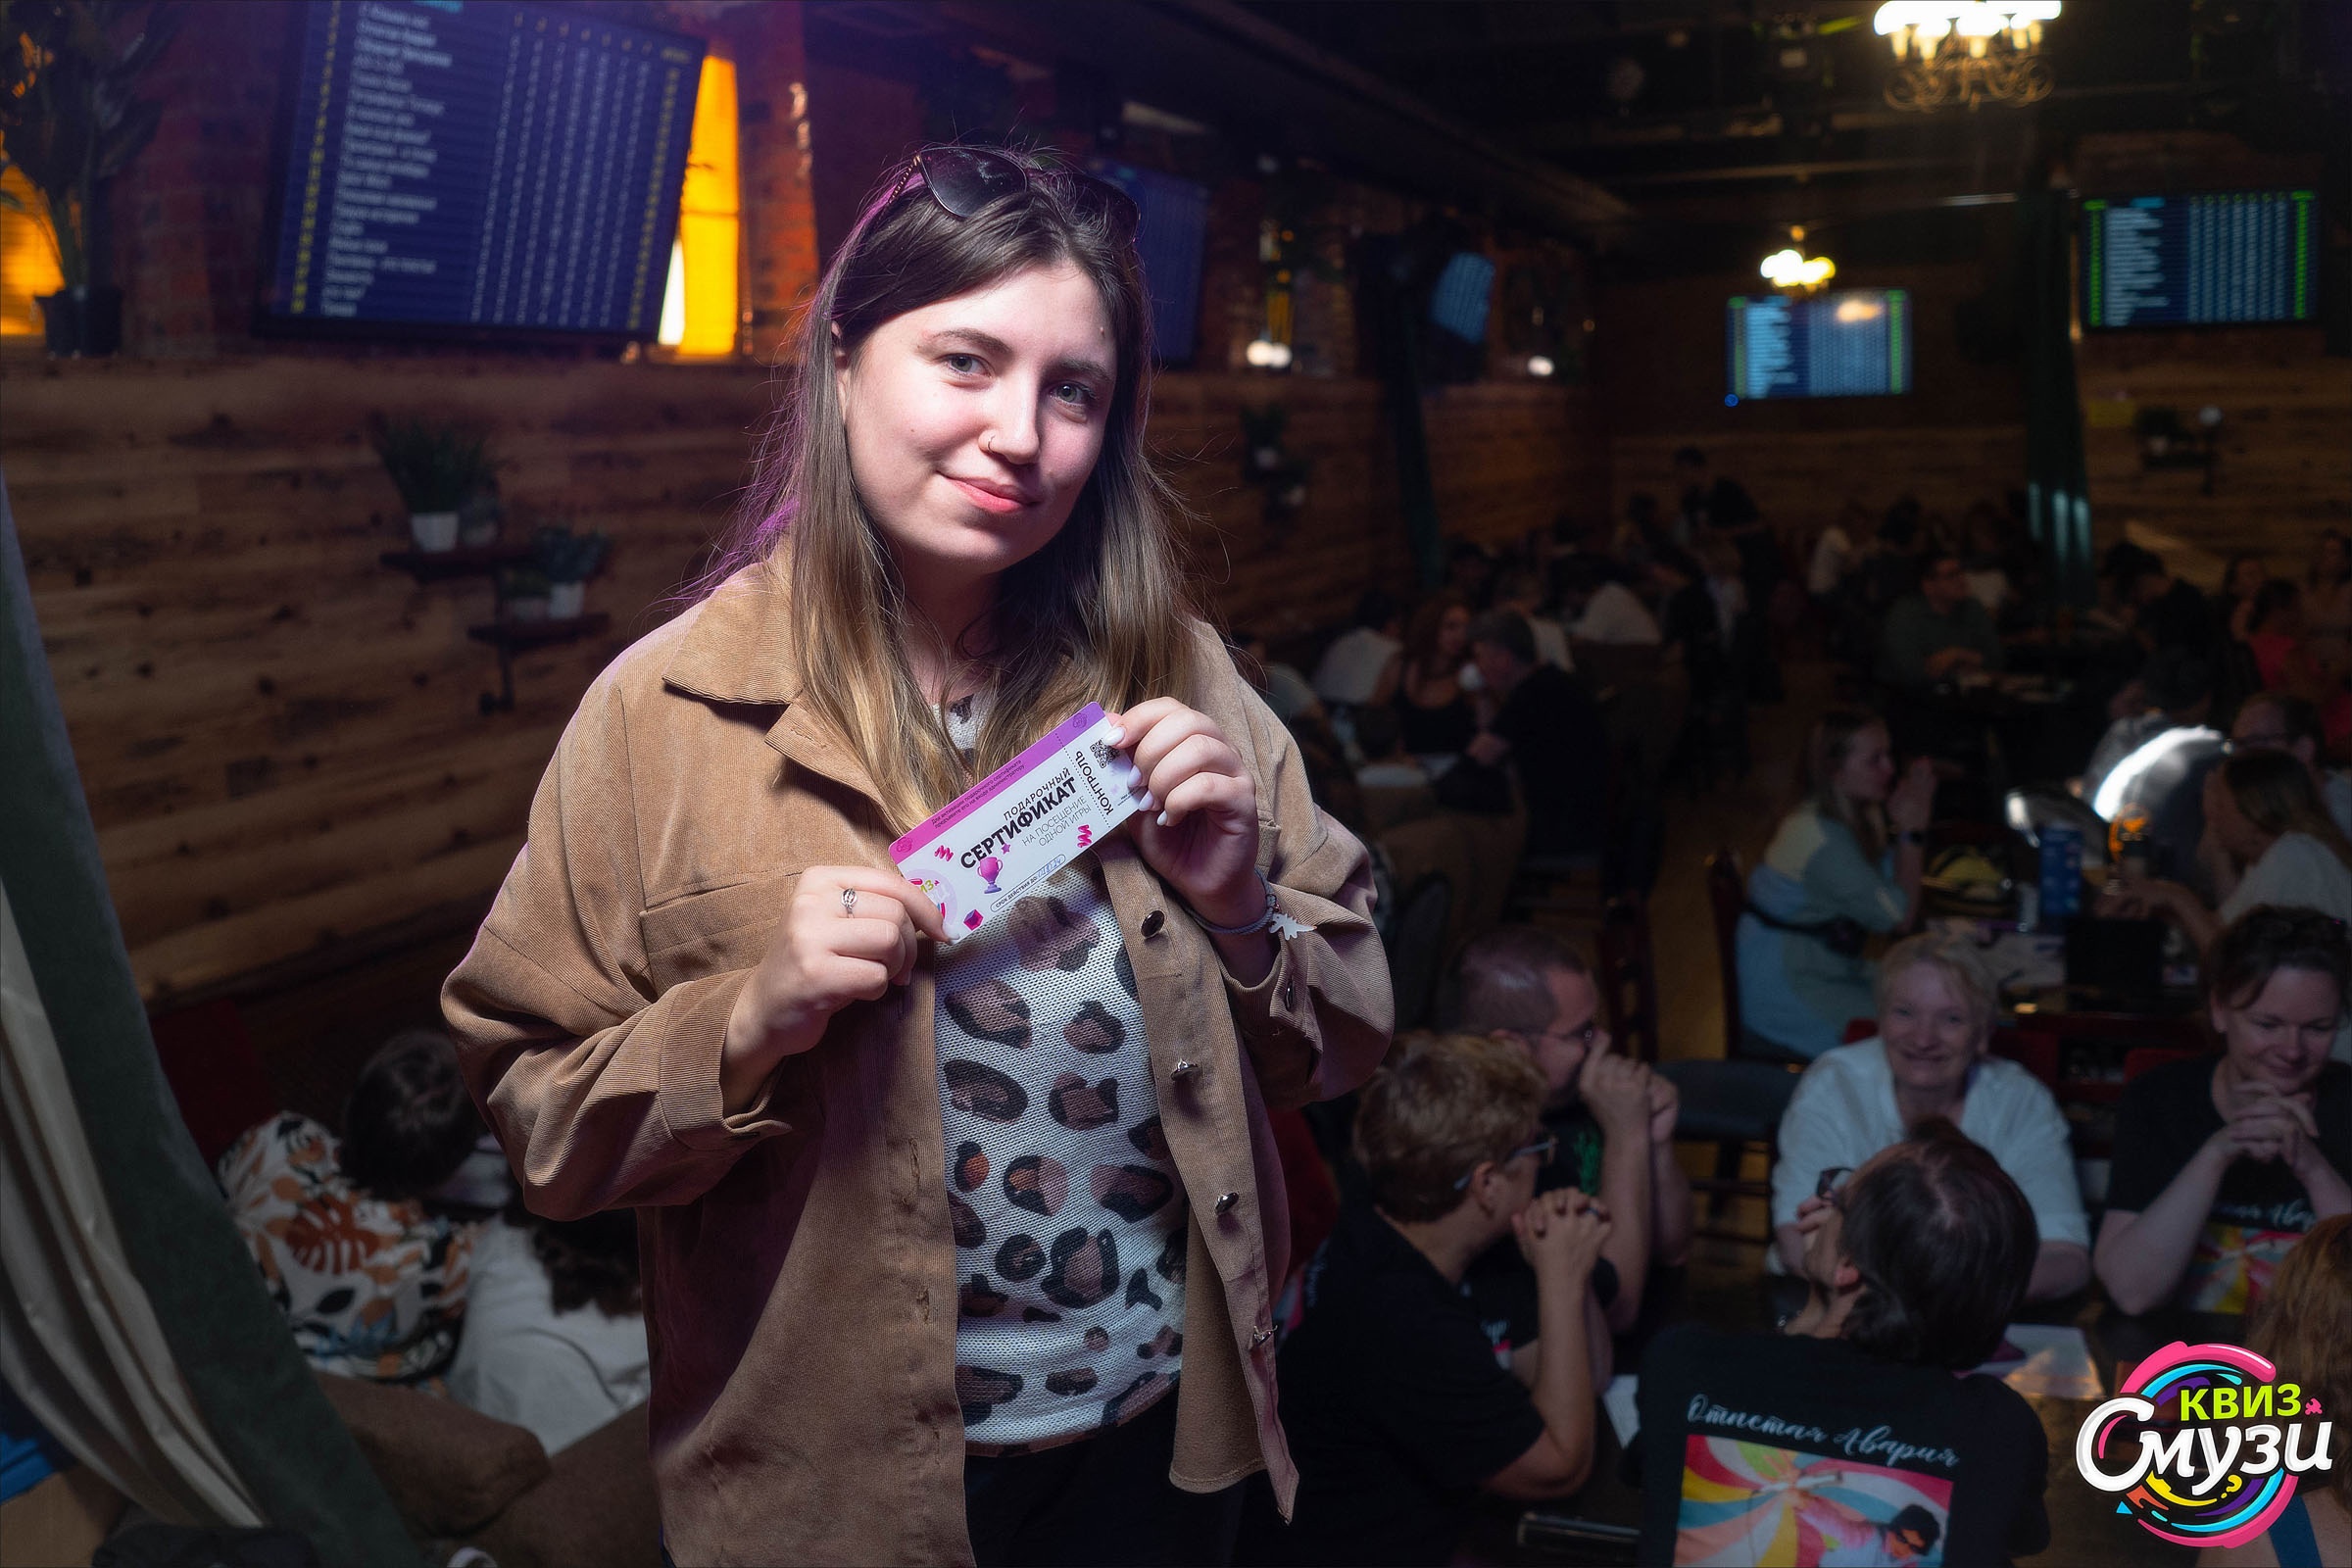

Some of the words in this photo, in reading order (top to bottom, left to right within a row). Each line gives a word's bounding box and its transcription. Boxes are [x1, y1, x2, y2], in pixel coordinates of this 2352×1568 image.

[963, 779, 993, 802] подарочного
[993, 759, 1021, 781] сертификата
[988, 763, 1025, 791] администратору
[1003, 766, 1070, 820] ПОДАРОЧНЫЙ
[1075, 751, 1113, 815] КОНТРОЛЬ
[960, 776, 1074, 868] СЕРТИФИКАТ
[1021, 832, 1035, 846] НА
[1035, 795, 1087, 836] ПОСЕЩЕНИЕ
[1038, 818, 1069, 847] ОДНОЙ
[1068, 804, 1091, 823] ИГРЫ
[995, 897, 1007, 907] СРОК
[1006, 881, 1030, 899] ДЕЙСТВИЯ
[1834, 1425, 1960, 1468] Авария
